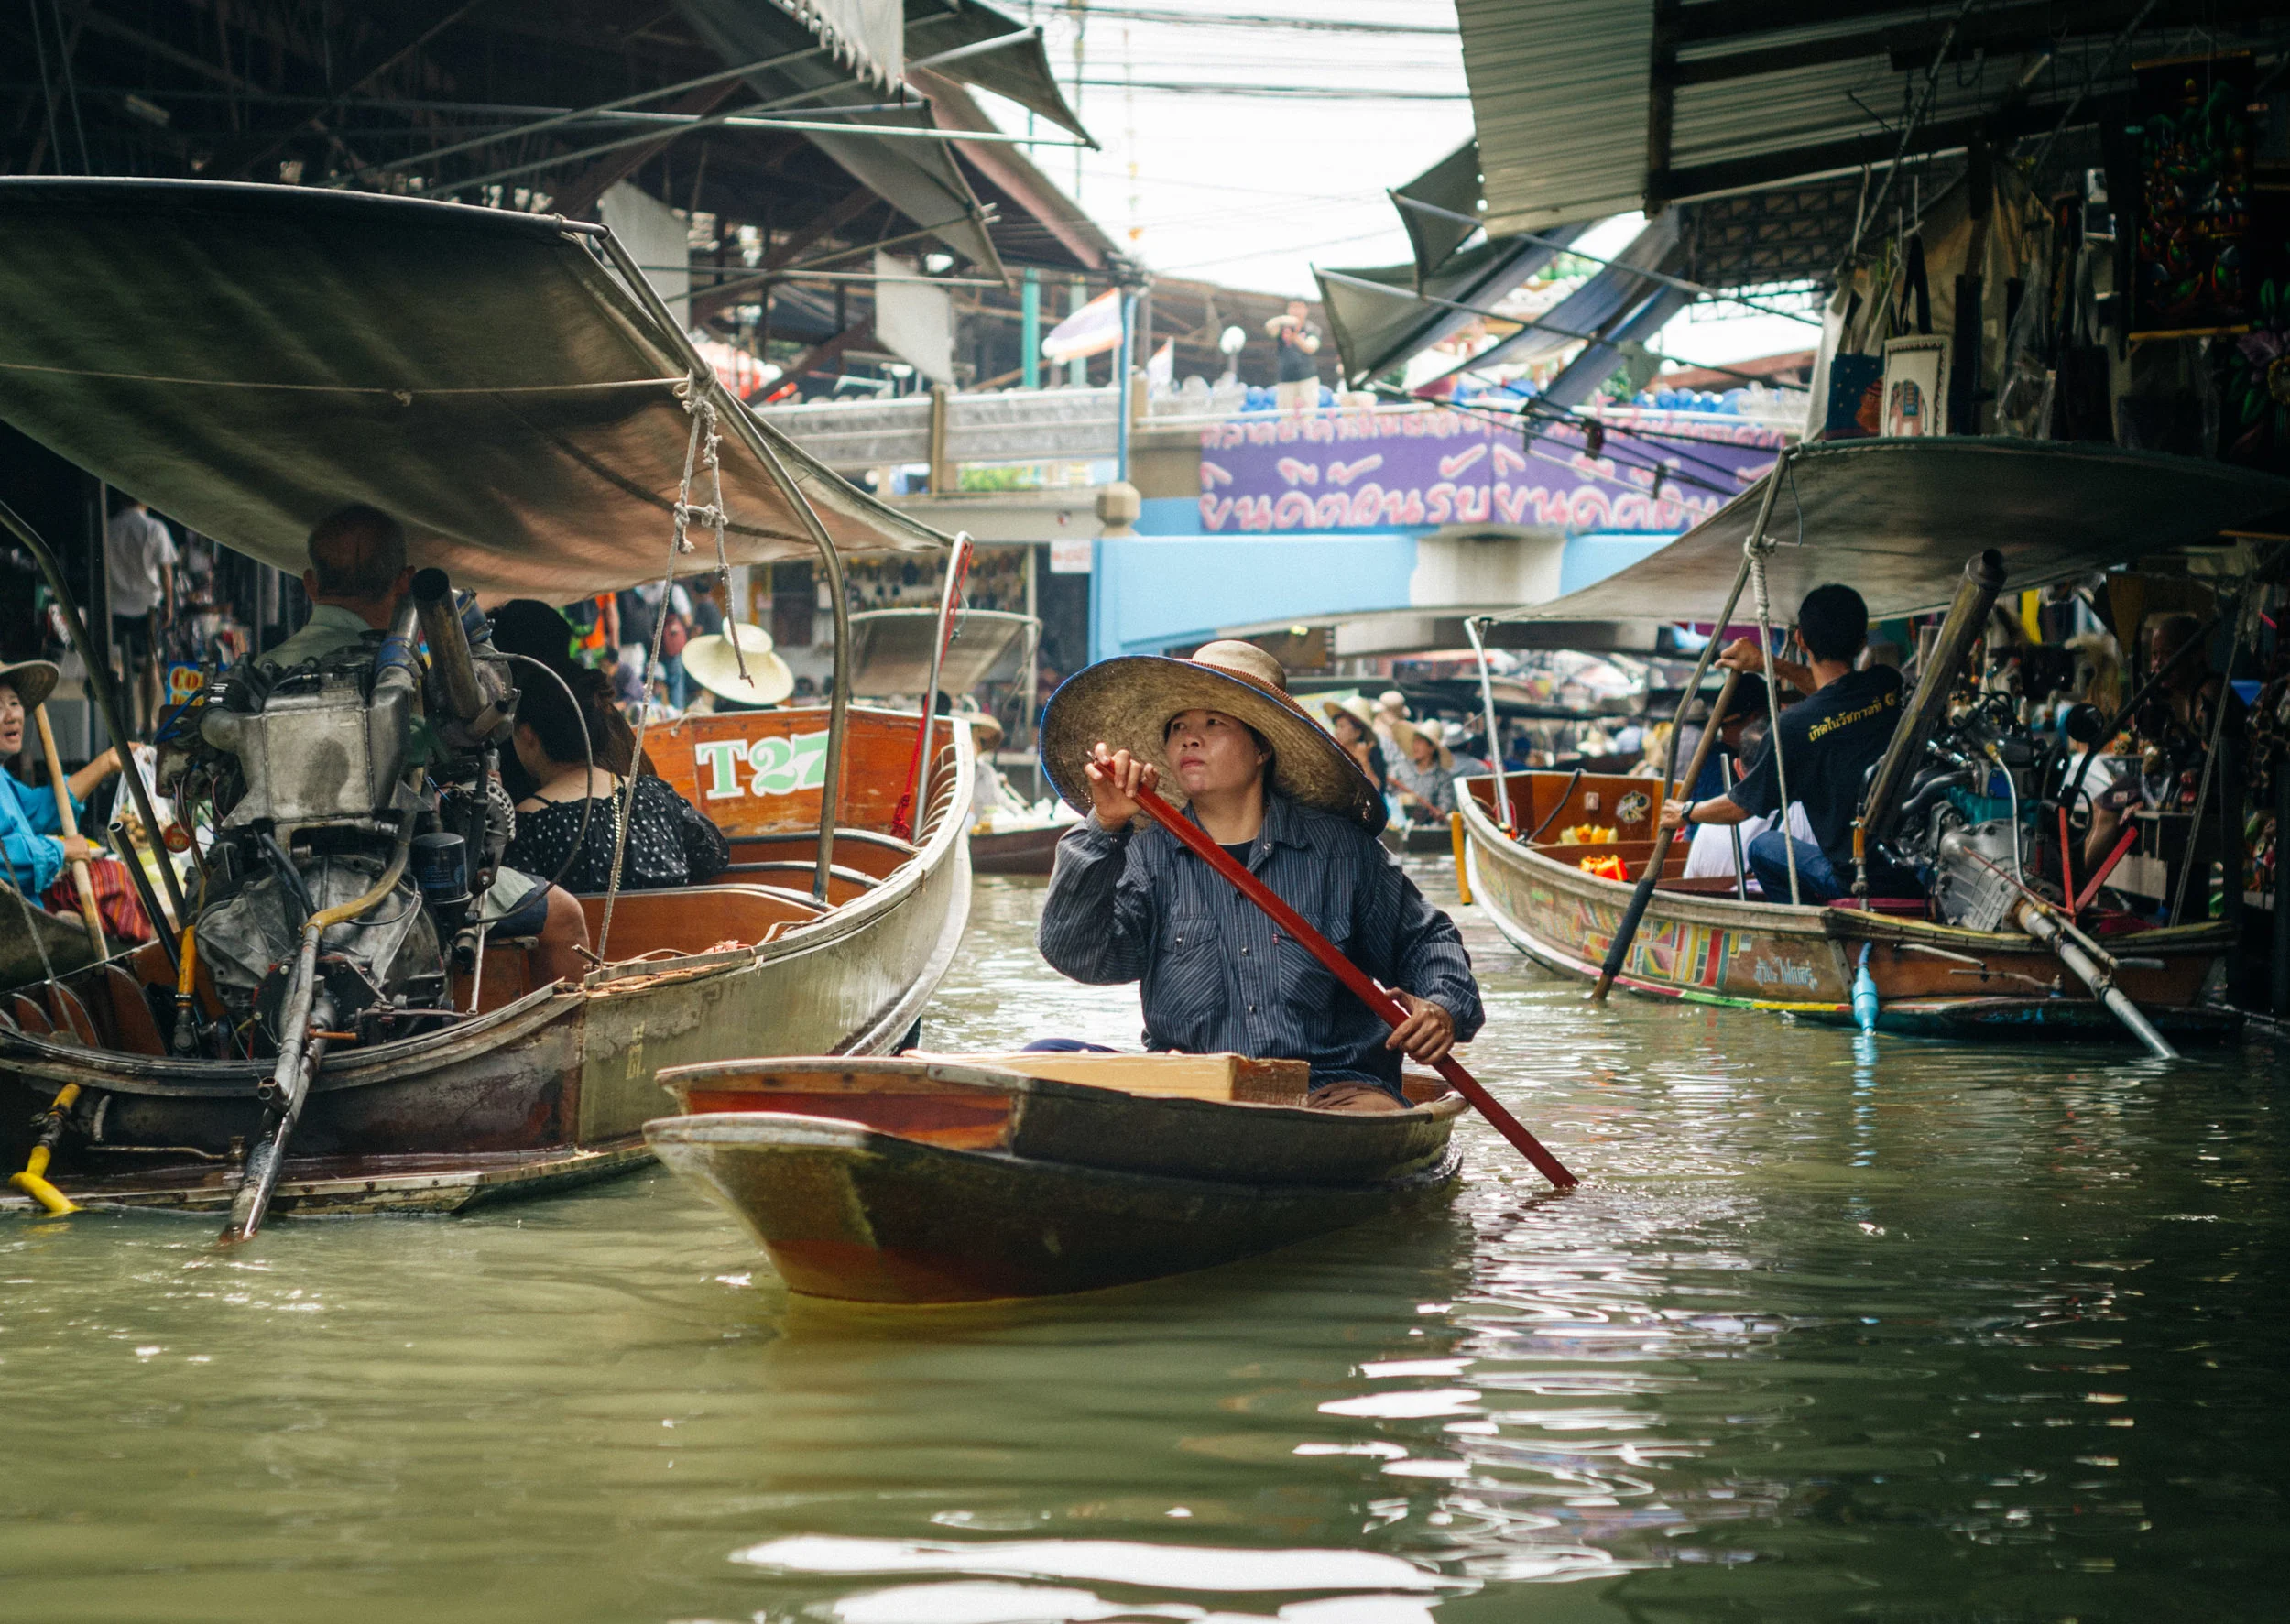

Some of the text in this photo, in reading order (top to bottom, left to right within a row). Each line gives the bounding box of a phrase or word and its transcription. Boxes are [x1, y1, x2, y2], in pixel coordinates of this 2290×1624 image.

[1198, 442, 1491, 531] ยินดีต้อนรับ
[694, 729, 830, 800] T27
